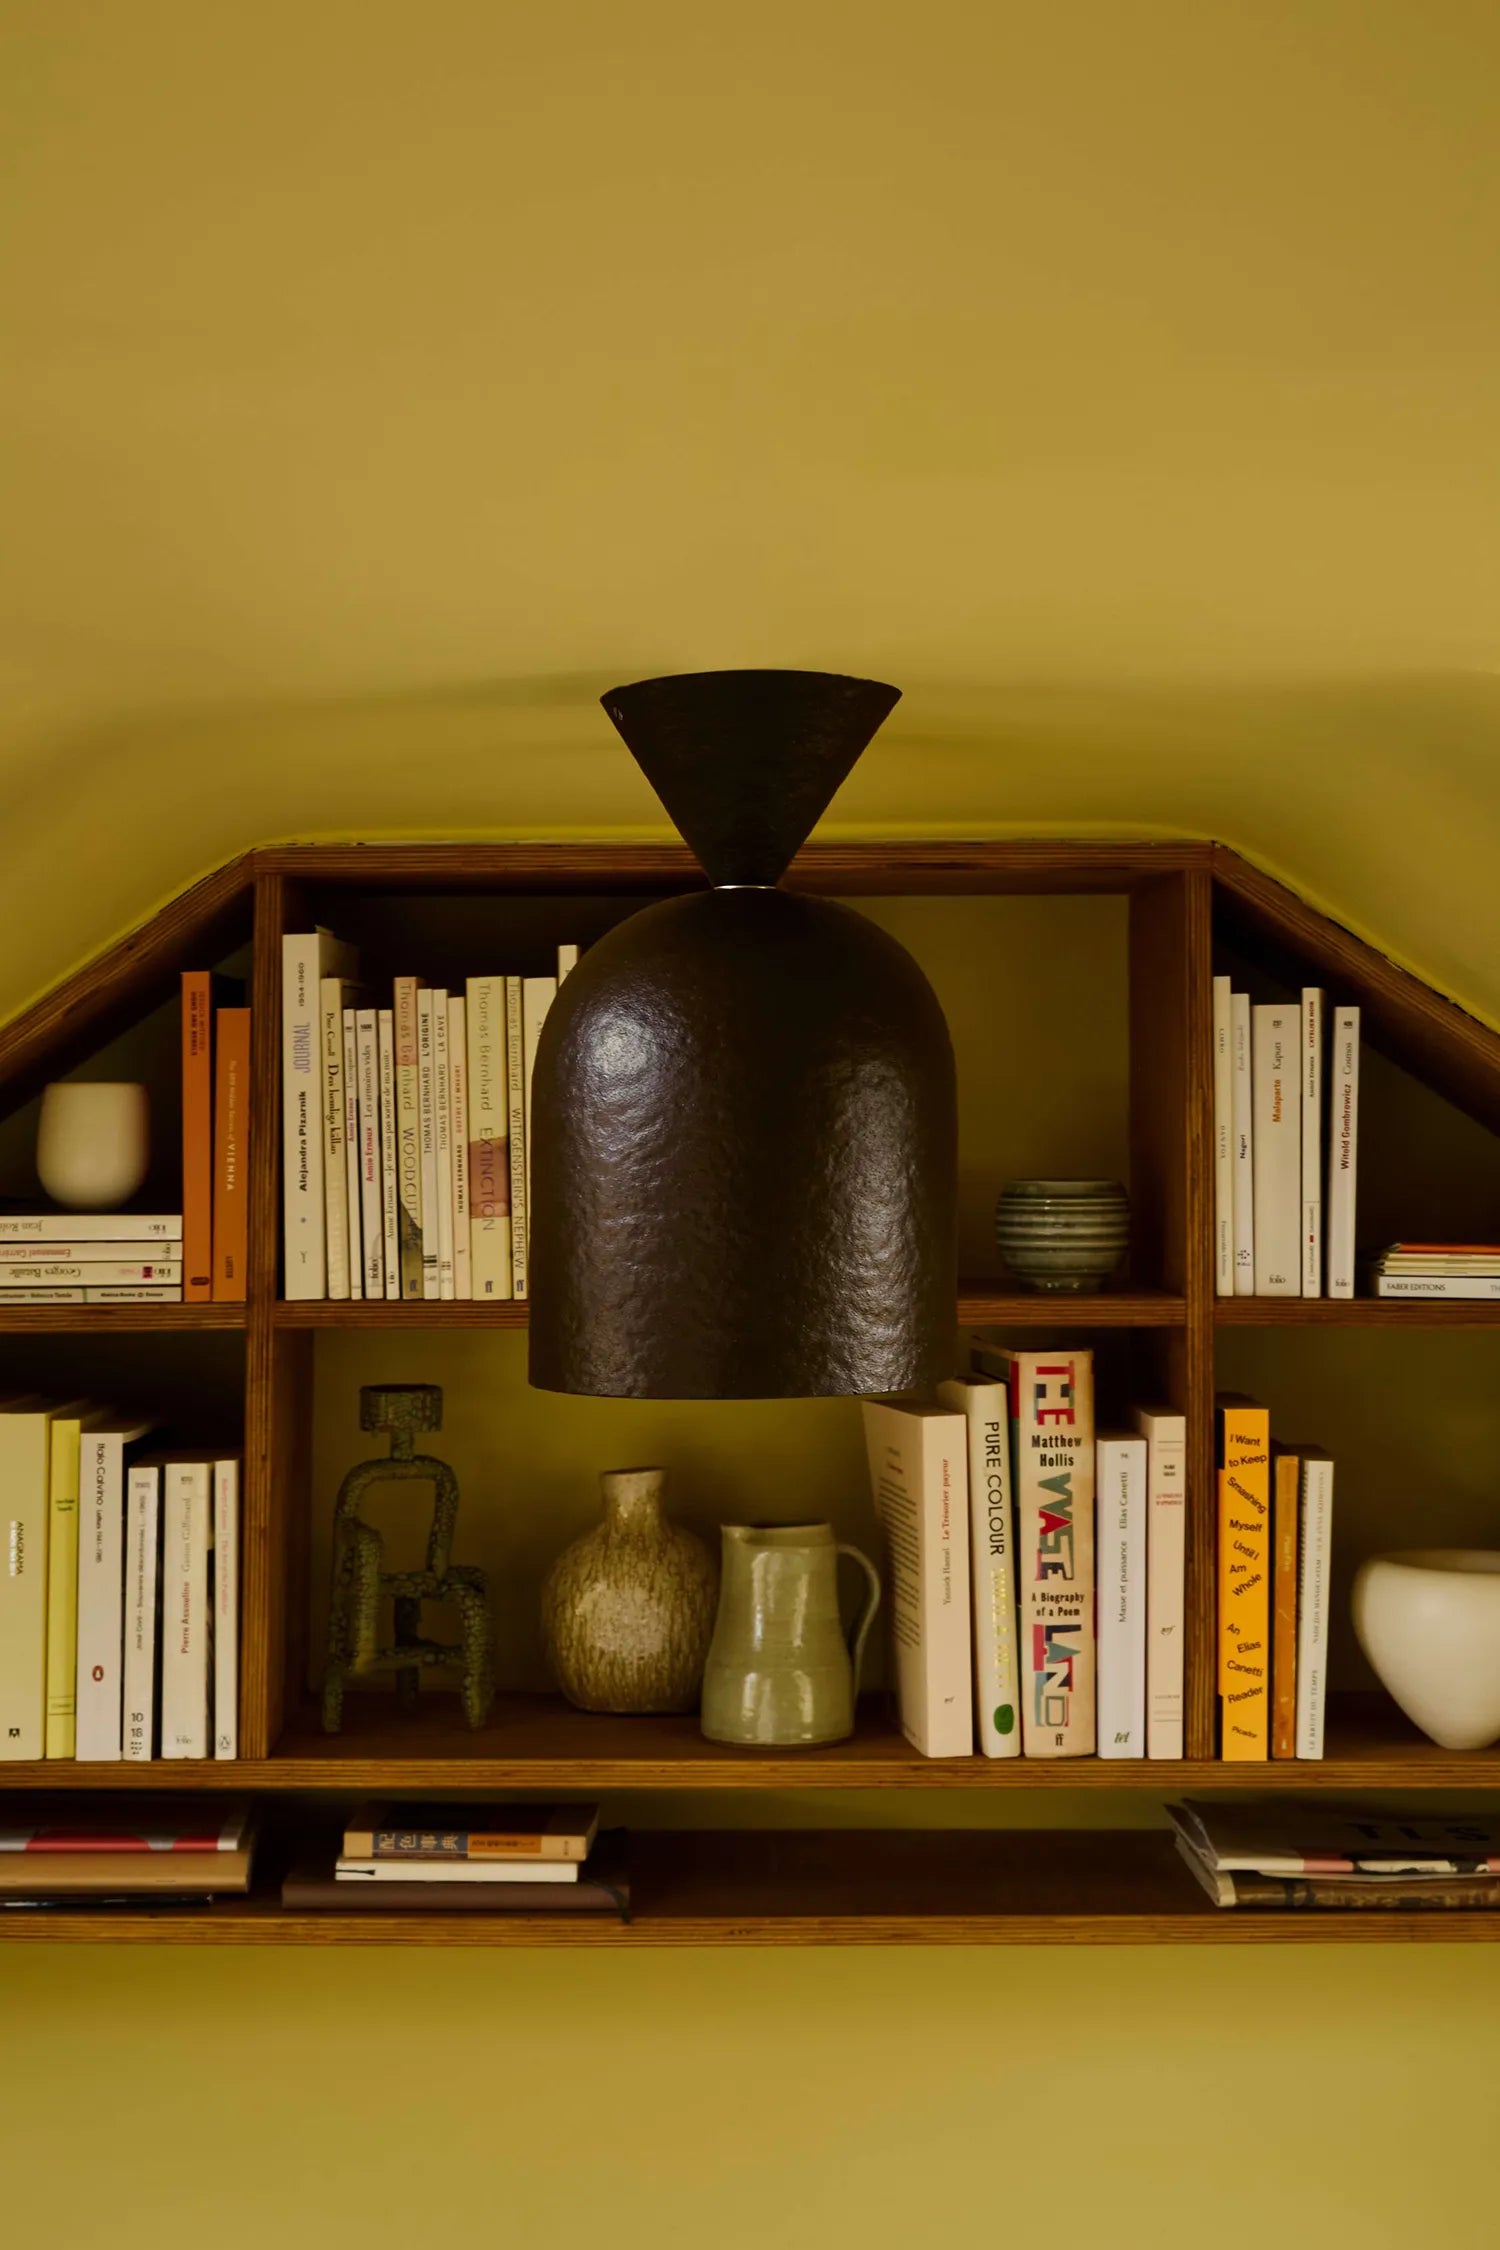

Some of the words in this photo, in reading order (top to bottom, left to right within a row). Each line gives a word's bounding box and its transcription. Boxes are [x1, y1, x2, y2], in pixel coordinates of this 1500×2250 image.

[398, 983, 412, 1040] Thomas
[478, 984, 492, 1039] Thomas
[508, 982, 520, 1030] Thomas
[420, 1012, 430, 1057] L'ORIGINE
[436, 1014, 445, 1037] CAVE
[1307, 1018, 1316, 1049] L'ATELIER
[292, 1022, 311, 1074] JOURNAL
[360, 1044, 371, 1065] vides
[438, 1041, 446, 1053] LA
[1341, 1042, 1353, 1076] Cosmos
[327, 1063, 340, 1088] Den
[400, 1044, 415, 1111] Bernhard
[479, 1044, 493, 1111] Bernhard
[510, 1034, 523, 1092] Bernhard
[362, 1066, 372, 1102] armoires
[382, 1087, 391, 1097] de
[422, 1066, 432, 1114] BERNHARD
[438, 1063, 448, 1111] BERNHARD
[1306, 1079, 1315, 1098] Annie
[298, 1090, 308, 1137] Pizarnik
[325, 1089, 342, 1125] hemliga
[363, 1104, 373, 1118] Les
[383, 1100, 392, 1119] sortie
[1272, 1079, 1285, 1123] Malaparte
[1341, 1084, 1352, 1139] Gombrowicz
[329, 1126, 342, 1155] källan
[364, 1126, 374, 1156] Ernaux
[385, 1120, 393, 1134] pas
[423, 1117, 433, 1154] THOMAS
[439, 1113, 449, 1151] THOMAS
[225, 1143, 236, 1192] VIENNA
[299, 1138, 310, 1192] Alejandra
[456, 1144, 464, 1182] BERNHARD
[1339, 1140, 1350, 1170] Witold
[364, 1157, 375, 1183] Annie
[479, 1127, 497, 1232] EXTINCTION
[384, 1185, 394, 1214] Ernaux
[457, 1184, 465, 1214] THOMAS
[385, 1216, 395, 1241] Annie
[513, 1215, 524, 1269] NEPHEW
[8, 1268, 42, 1279] Bataille
[43, 1265, 82, 1278] Georges
[366, 1258, 380, 1279] folio
[1386, 1282, 1409, 1291] FABER
[1409, 1283, 1447, 1293] EDITIONS
[96, 1443, 106, 1465] Italo
[984, 1421, 1001, 1468] PURE
[1031, 1434, 1083, 1449] Matthew
[1229, 1433, 1234, 1443] I
[1235, 1434, 1261, 1448] Want
[941, 1458, 951, 1487] payeur
[1039, 1453, 1075, 1468] Hollis
[1228, 1459, 1239, 1468] to
[1239, 1454, 1268, 1466] Keep
[96, 1466, 106, 1506] Calvino
[1119, 1471, 1129, 1507] Canetti
[1227, 1476, 1267, 1515] Smashing
[940, 1489, 950, 1528] Trésorier
[986, 1474, 1006, 1557] COLOUR
[1119, 1507, 1128, 1530] Elias
[941, 1529, 950, 1541] Le
[1229, 1519, 1263, 1533] Myself
[16, 1520, 25, 1576] ANAGRAMA
[1118, 1540, 1130, 1583] puissance
[1232, 1539, 1256, 1560] Until
[1253, 1551, 1260, 1561] I
[1229, 1563, 1247, 1574] Am
[1031, 1592, 1037, 1602] A
[1040, 1592, 1086, 1605] Biography
[1119, 1584, 1128, 1594] et
[1231, 1573, 1262, 1597] Whole
[181, 1581, 190, 1625] Assouline
[1035, 1606, 1047, 1617] of
[1048, 1608, 1055, 1617] a
[1057, 1606, 1081, 1617] Poem
[1118, 1594, 1128, 1623] Masse
[180, 1626, 190, 1654] Pierre
[1226, 1622, 1241, 1636] An
[1236, 1640, 1262, 1654] Elias
[1226, 1659, 1264, 1678] Canetti
[1227, 1686, 1264, 1704] Reader
[131, 1712, 144, 1723] 10
[131, 1727, 144, 1739] 18
